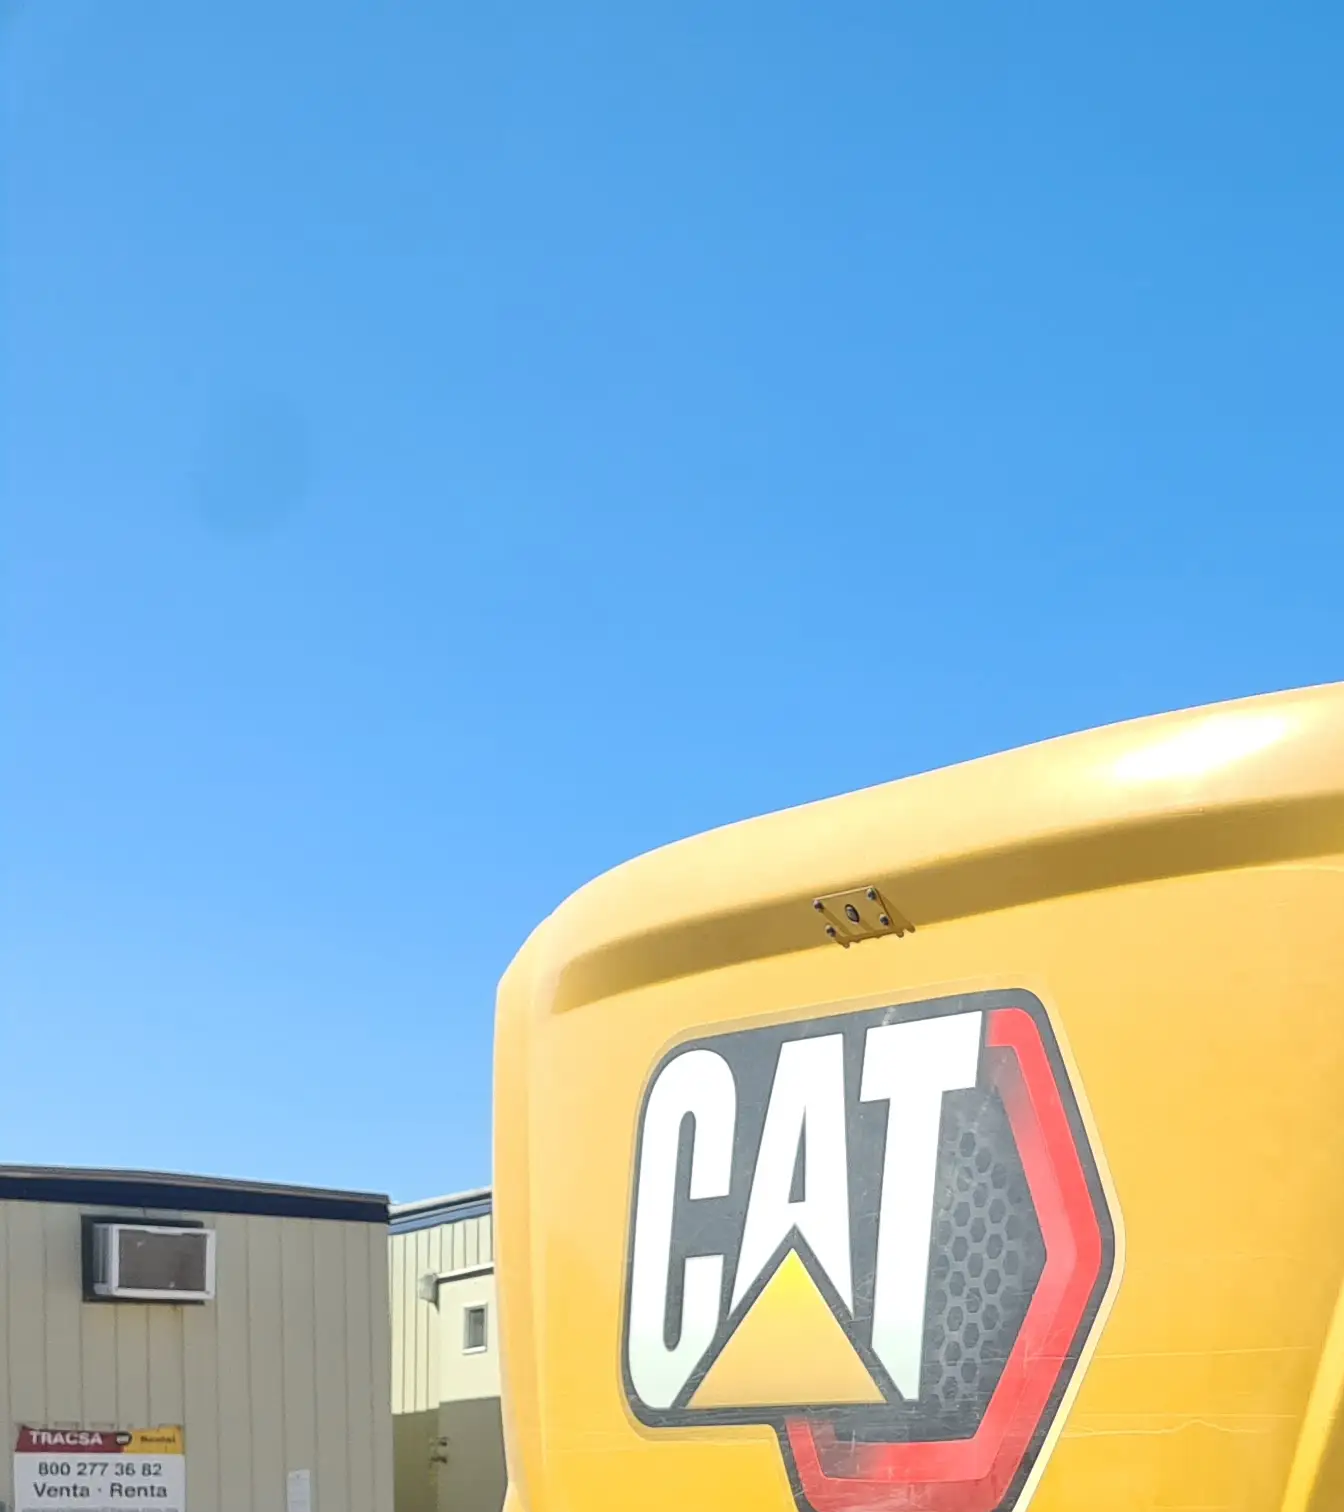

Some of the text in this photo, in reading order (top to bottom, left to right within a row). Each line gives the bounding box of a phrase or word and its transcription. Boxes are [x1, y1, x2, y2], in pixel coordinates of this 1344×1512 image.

[628, 1010, 982, 1409] CAT
[29, 1430, 103, 1445] TRACSA
[38, 1462, 162, 1476] 800 277 36 82
[33, 1482, 167, 1499] Venta Renta
